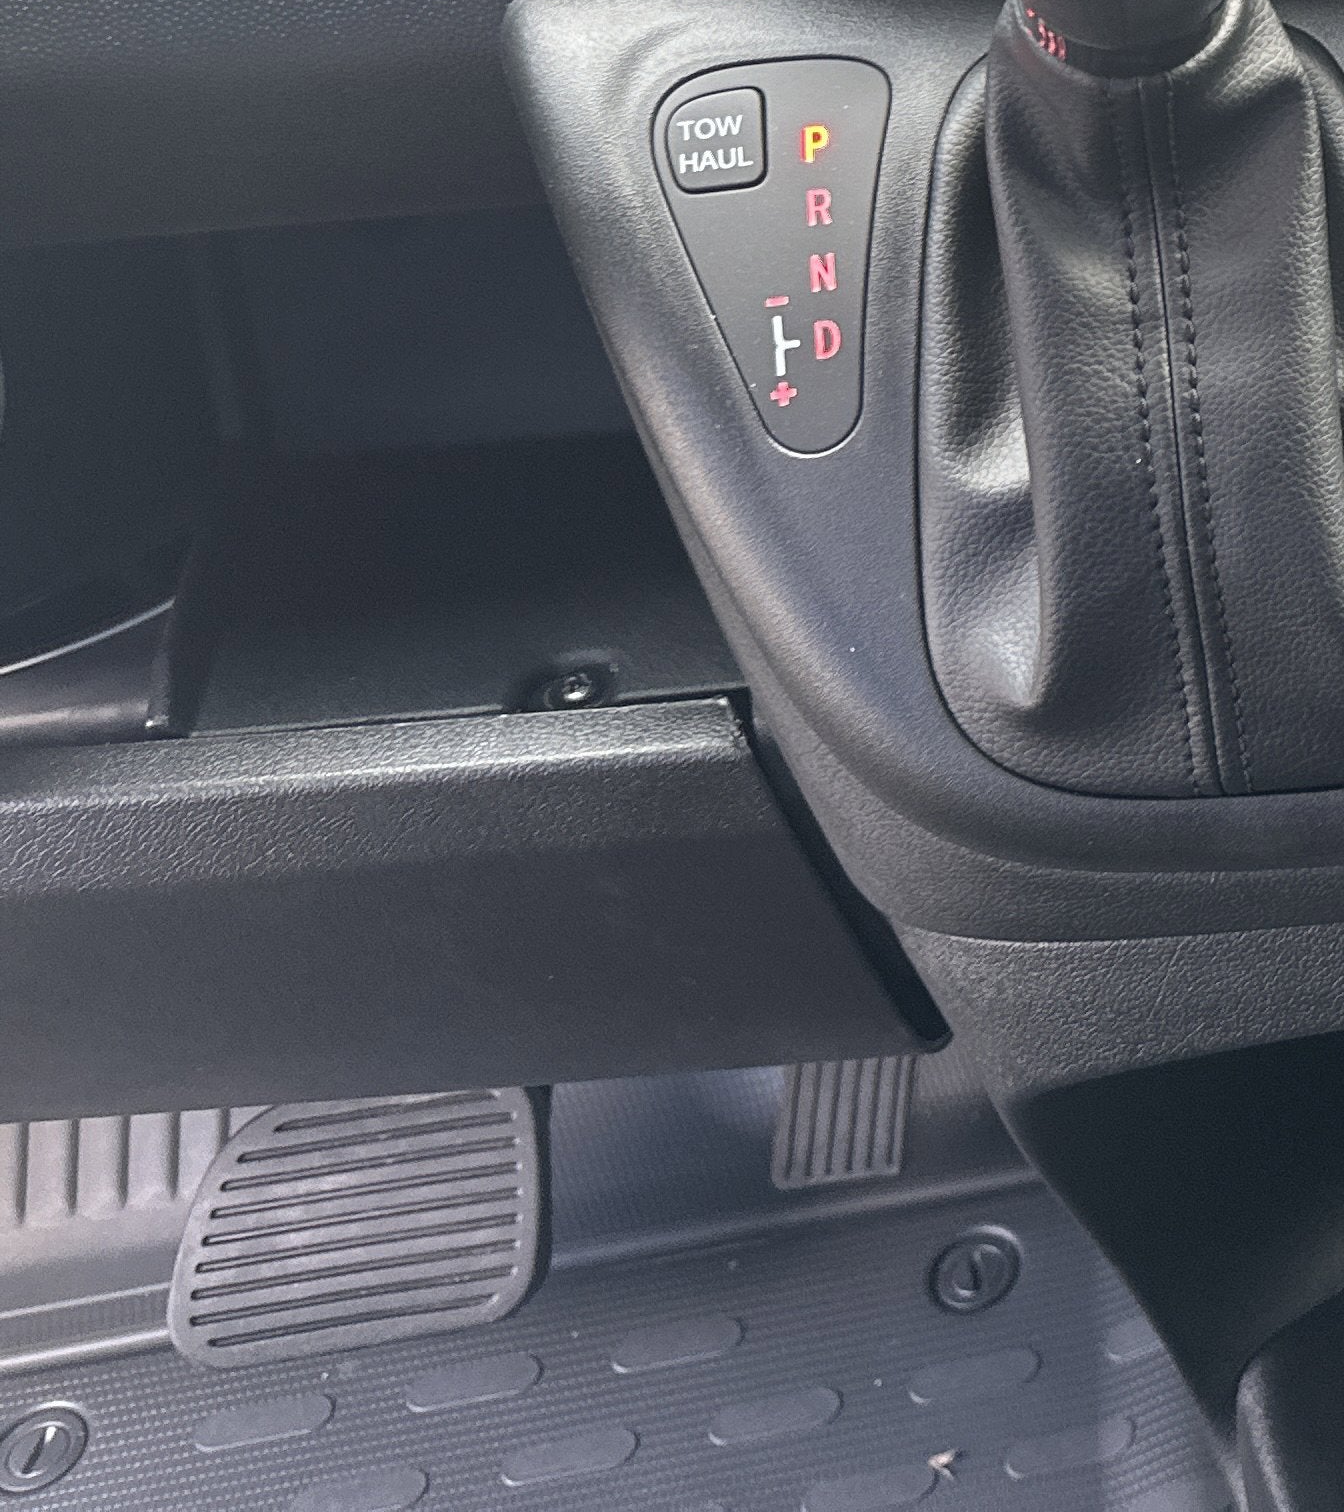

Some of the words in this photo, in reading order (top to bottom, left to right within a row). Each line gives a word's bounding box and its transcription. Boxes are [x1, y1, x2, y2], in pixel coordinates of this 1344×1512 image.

[677, 114, 744, 141] TOW
[799, 124, 830, 163] P
[679, 146, 754, 174] HAUL
[805, 188, 833, 227] R
[809, 252, 838, 293] N
[813, 319, 842, 360] D
